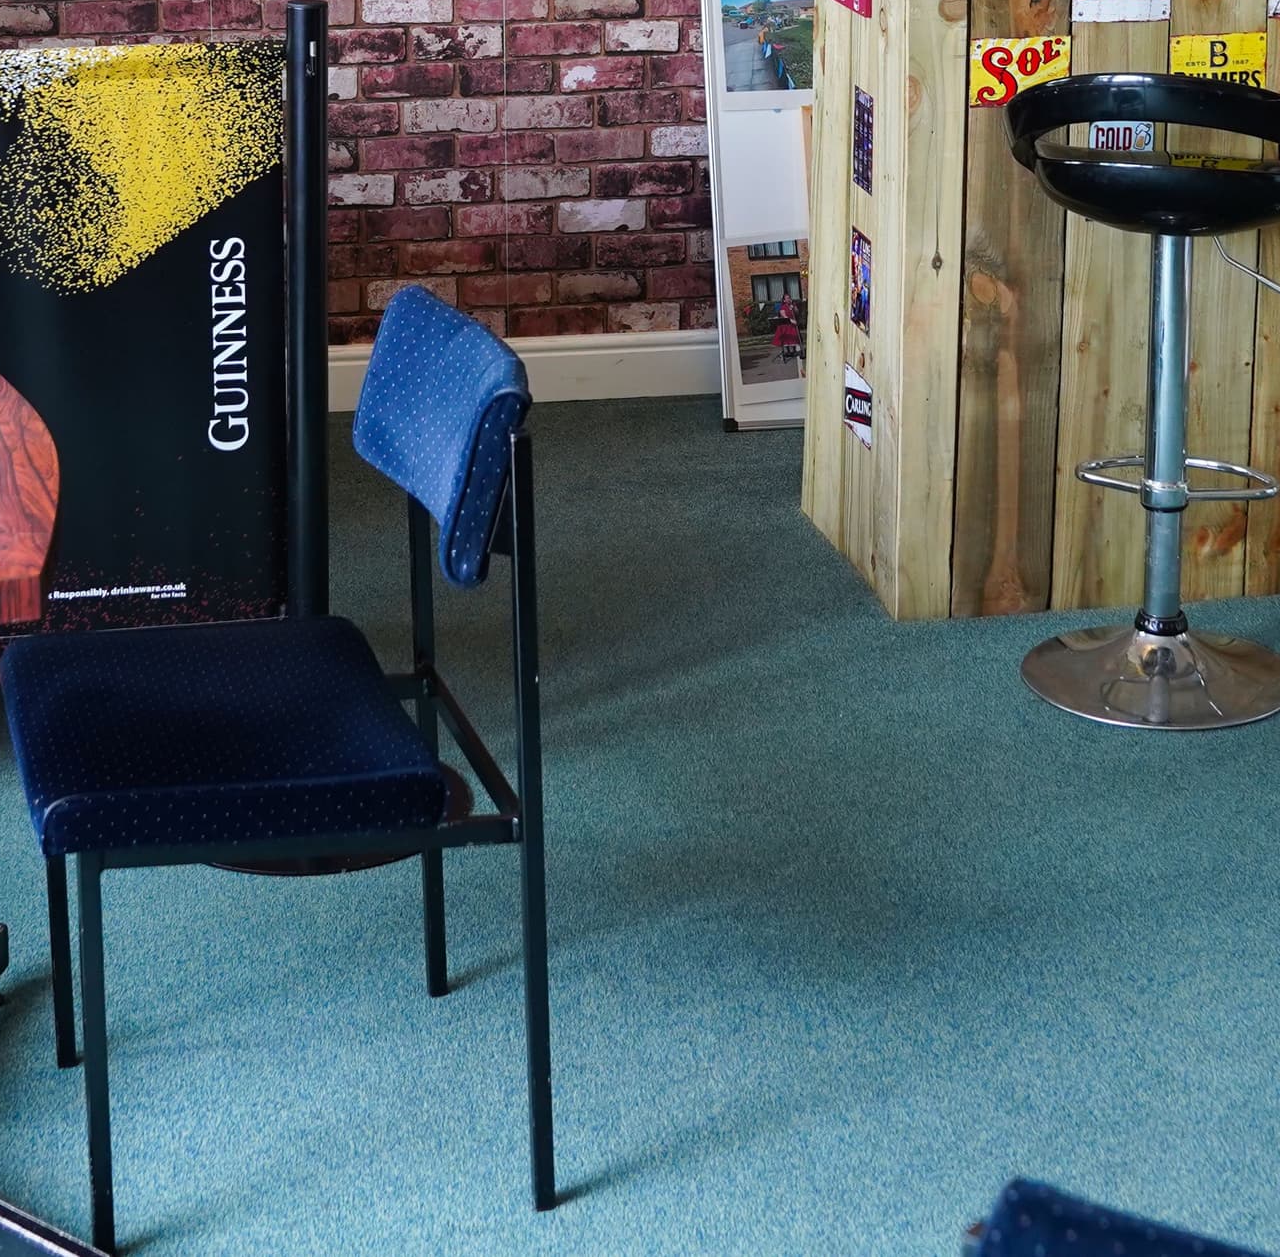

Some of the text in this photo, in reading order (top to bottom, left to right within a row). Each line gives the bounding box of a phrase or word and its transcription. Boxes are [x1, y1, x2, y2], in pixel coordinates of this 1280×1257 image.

[1209, 40, 1228, 68] B
[208, 237, 249, 451] GUINNESS
[845, 395, 872, 417] CARLING
[111, 582, 187, 594] drinkaware.co.uk
